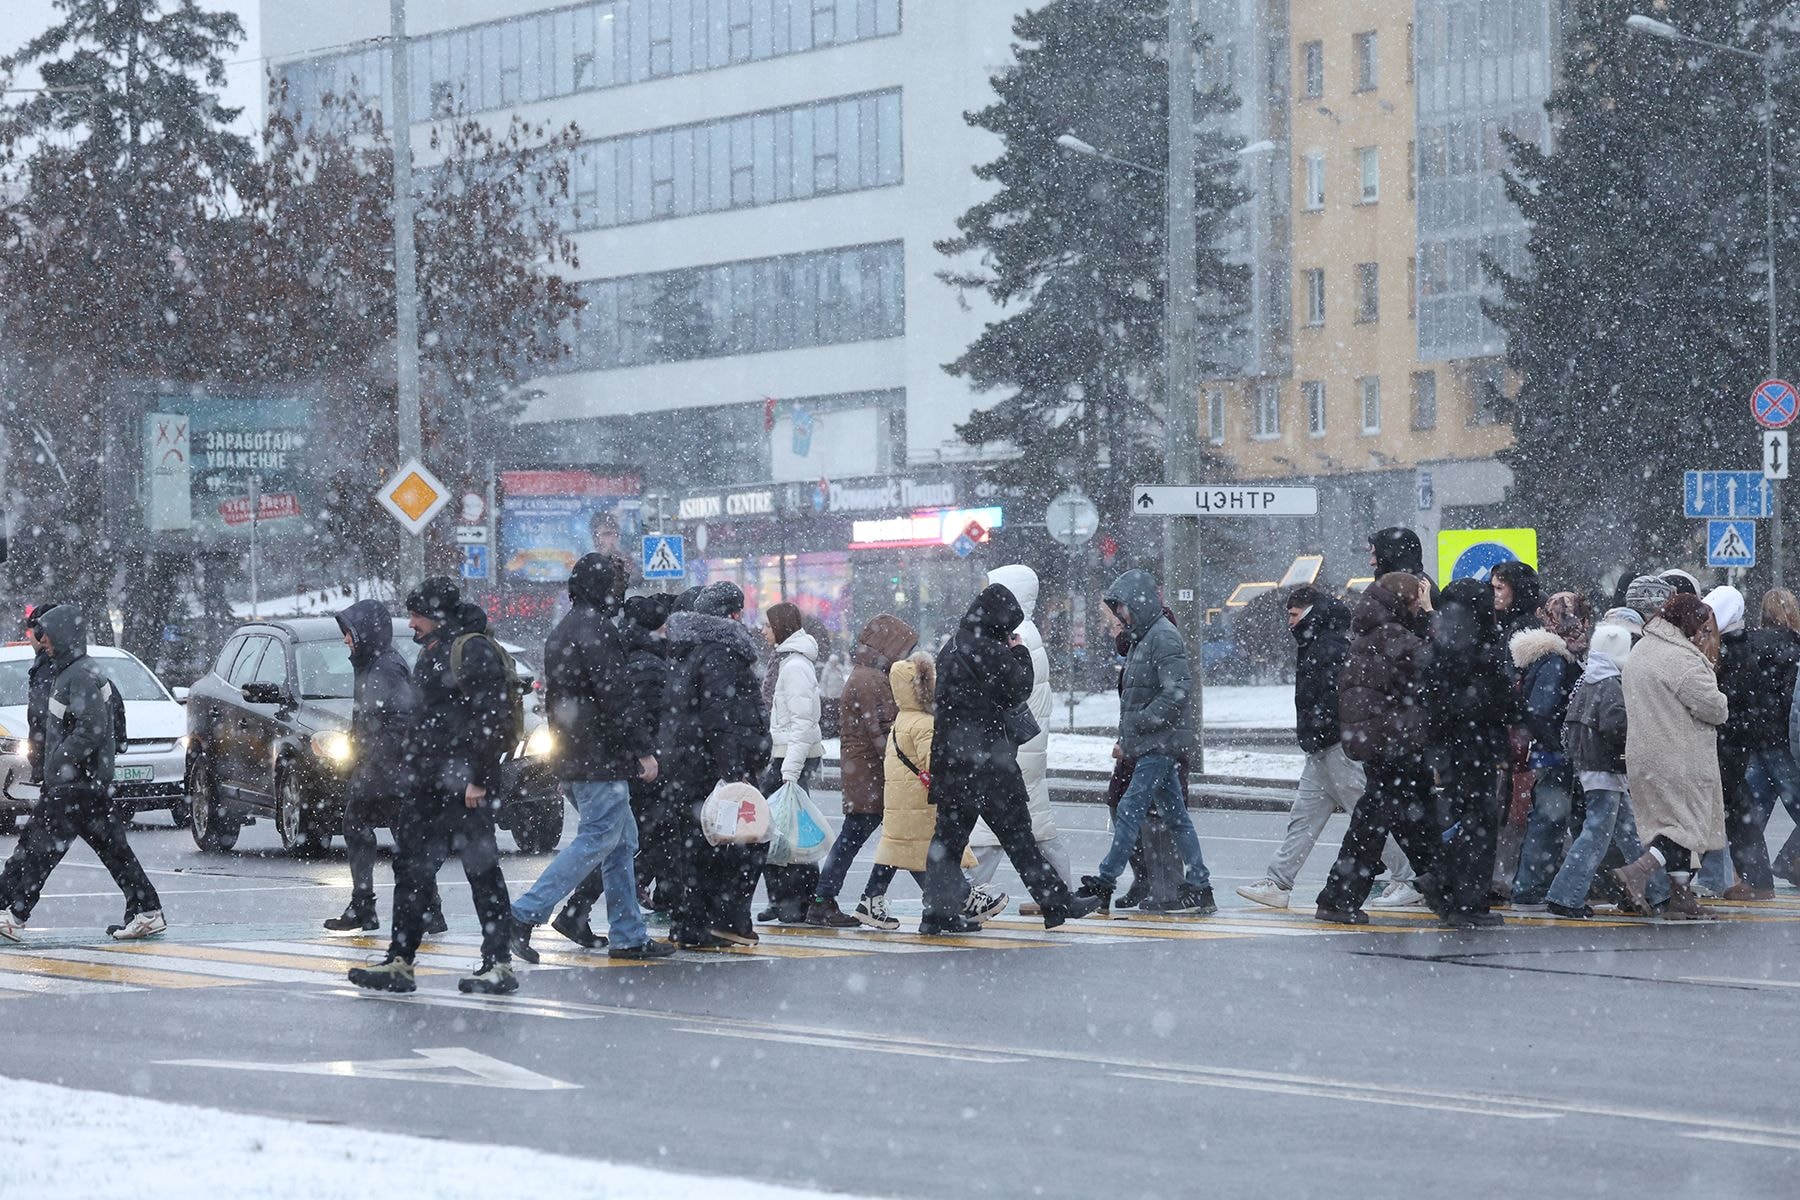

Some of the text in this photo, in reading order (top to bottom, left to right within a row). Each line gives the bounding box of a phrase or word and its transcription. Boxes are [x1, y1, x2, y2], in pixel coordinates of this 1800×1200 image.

[206, 450, 286, 469] УВАЖЕНИЕ
[679, 496, 720, 520] ASHION
[726, 491, 775, 515] CENTRE
[1195, 491, 1276, 512] ЦЭНТР
[1182, 591, 1191, 599] 13
